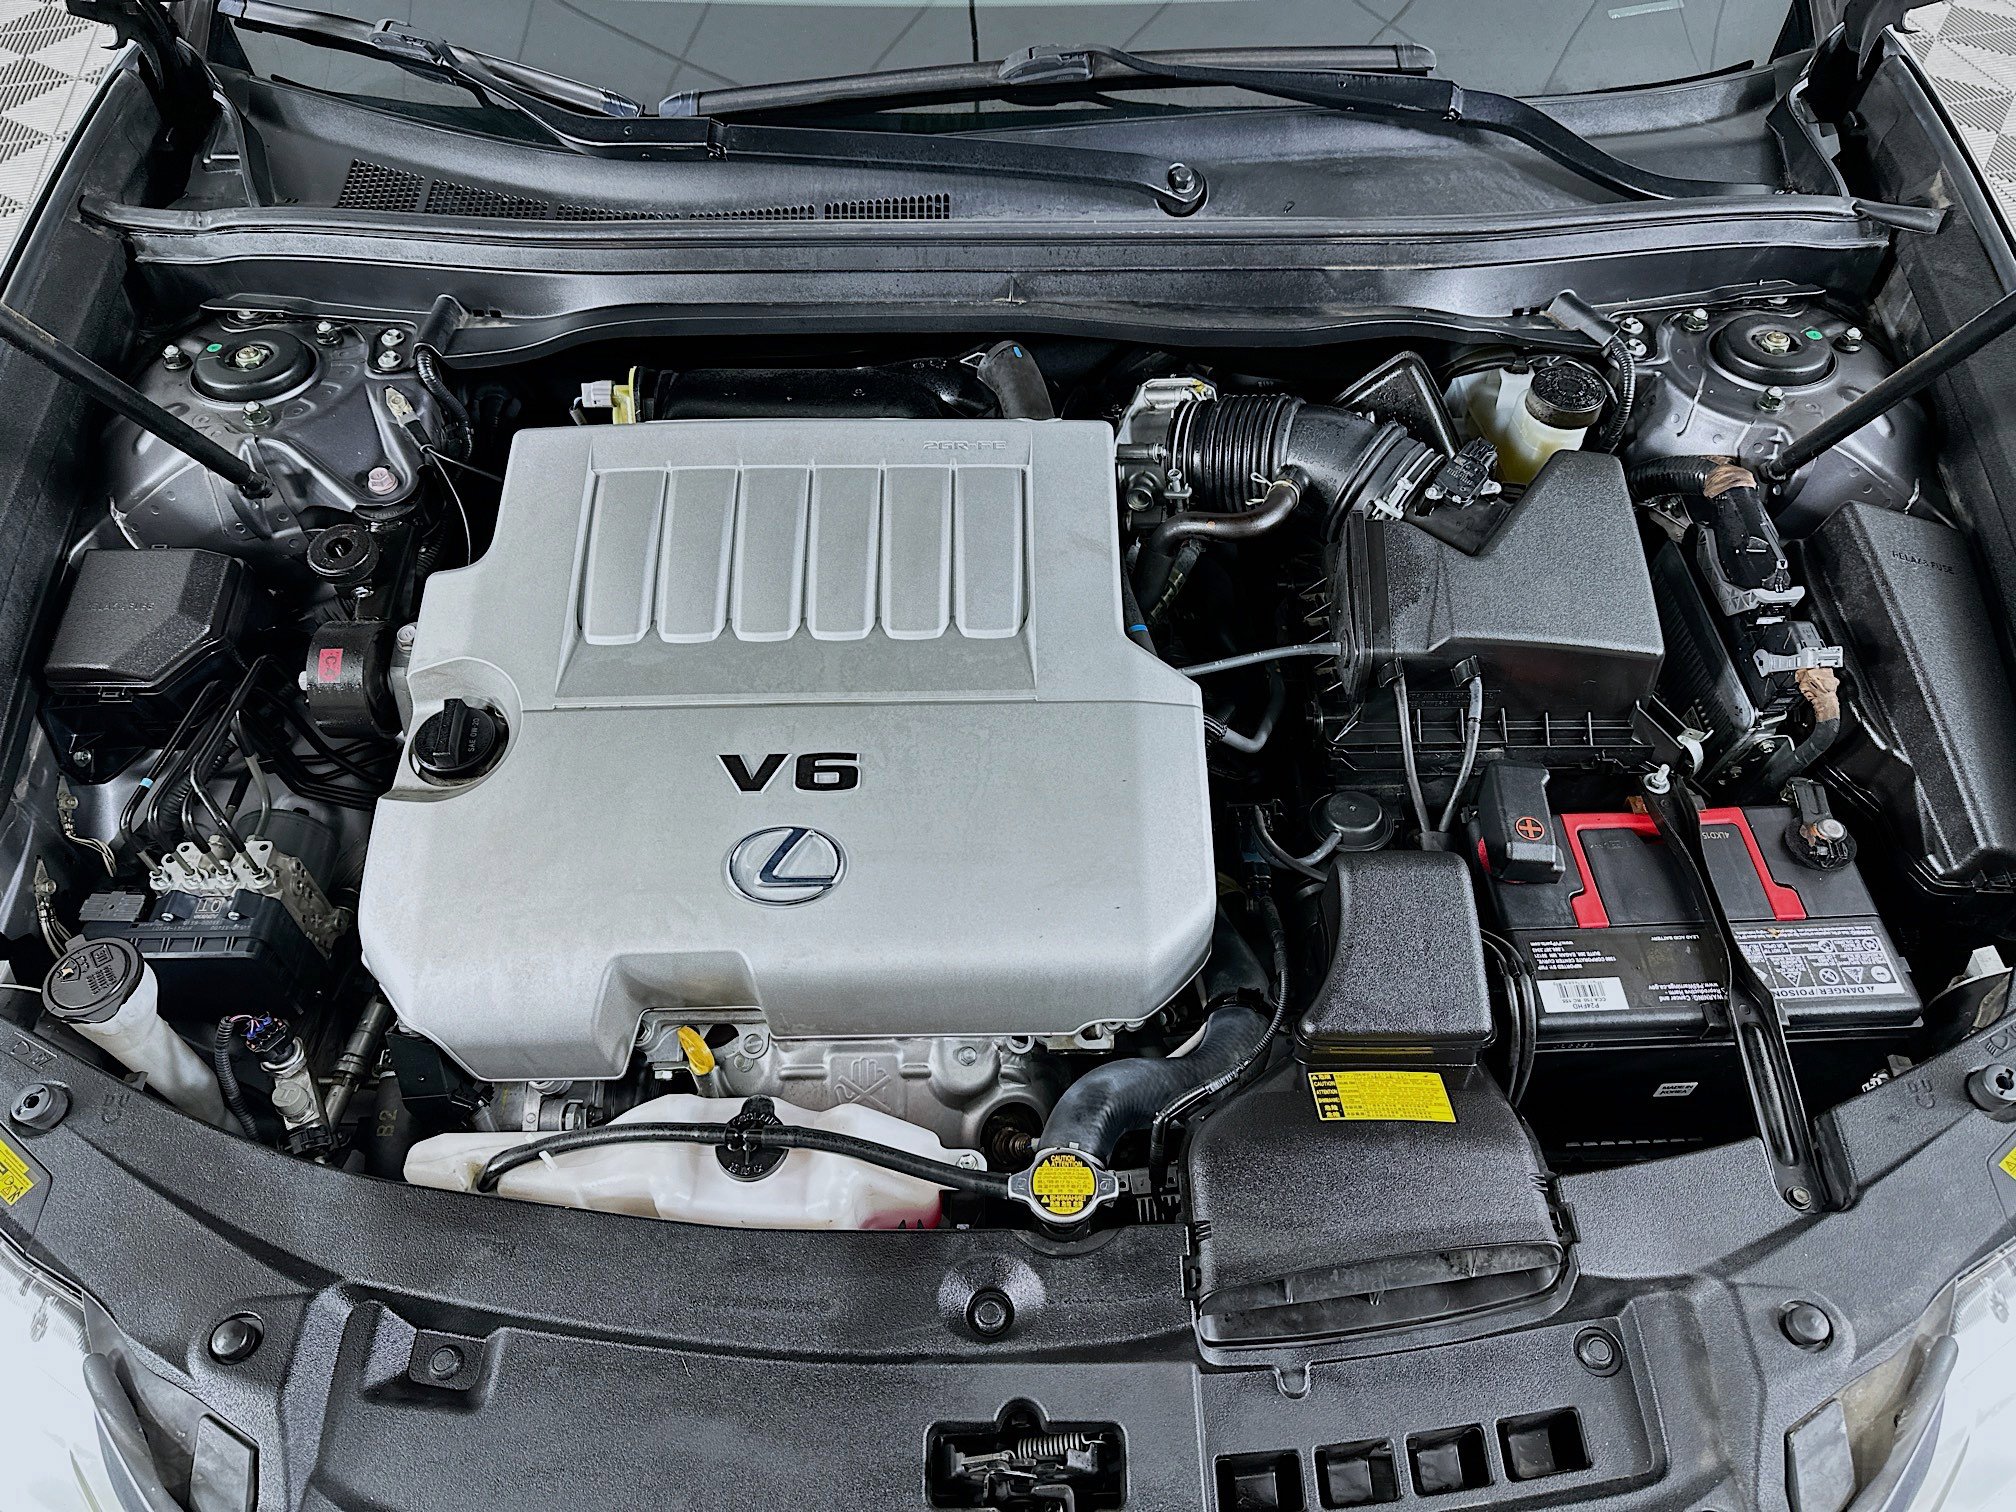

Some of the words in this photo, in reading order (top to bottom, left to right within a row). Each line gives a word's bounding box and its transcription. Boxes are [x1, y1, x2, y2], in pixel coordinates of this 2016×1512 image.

[922, 440, 1006, 450] 2GR-FE
[470, 717, 480, 738] 0W-20
[467, 739, 477, 753] SAE
[716, 752, 861, 795] V6
[1691, 993, 1724, 1001] WARNING:
[1572, 1002, 1600, 1010] P24FHD
